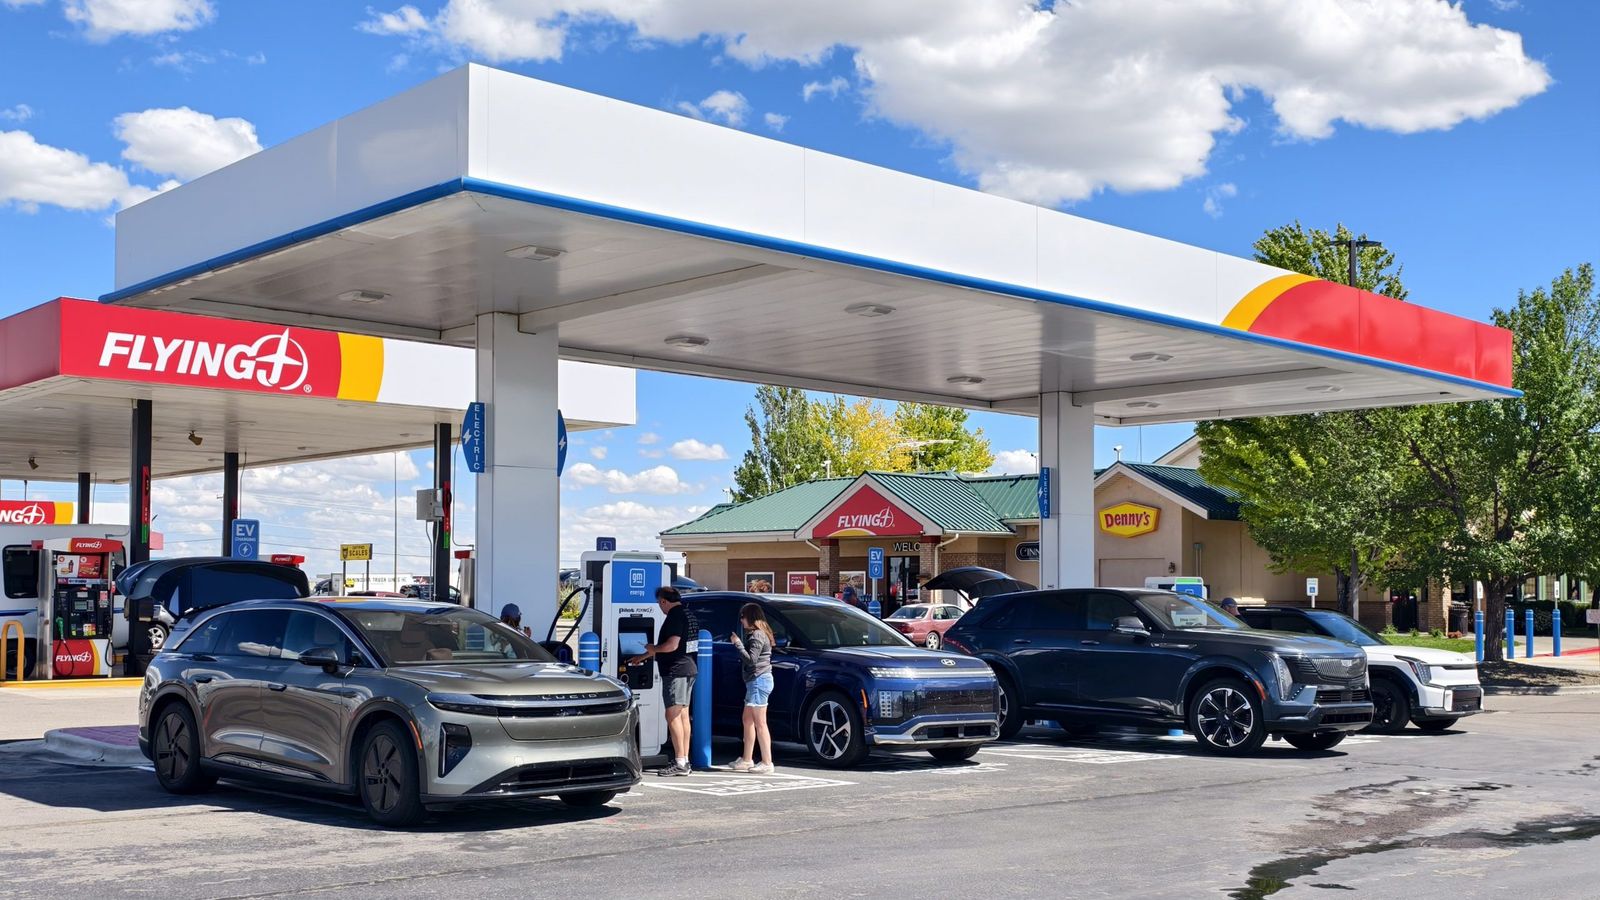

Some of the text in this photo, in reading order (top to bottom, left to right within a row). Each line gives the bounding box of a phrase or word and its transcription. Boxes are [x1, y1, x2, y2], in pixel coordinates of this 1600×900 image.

[98, 331, 257, 380] FLYING
[473, 404, 481, 470] ELECTRIC
[837, 513, 882, 528] FLYING
[1104, 511, 1151, 529] Denny's
[235, 523, 255, 537] EV
[348, 549, 369, 557] SCALES
[870, 551, 882, 560] EV
[632, 573, 643, 584] gm
[55, 654, 81, 662] FLYING
[541, 692, 598, 701] LUCID
